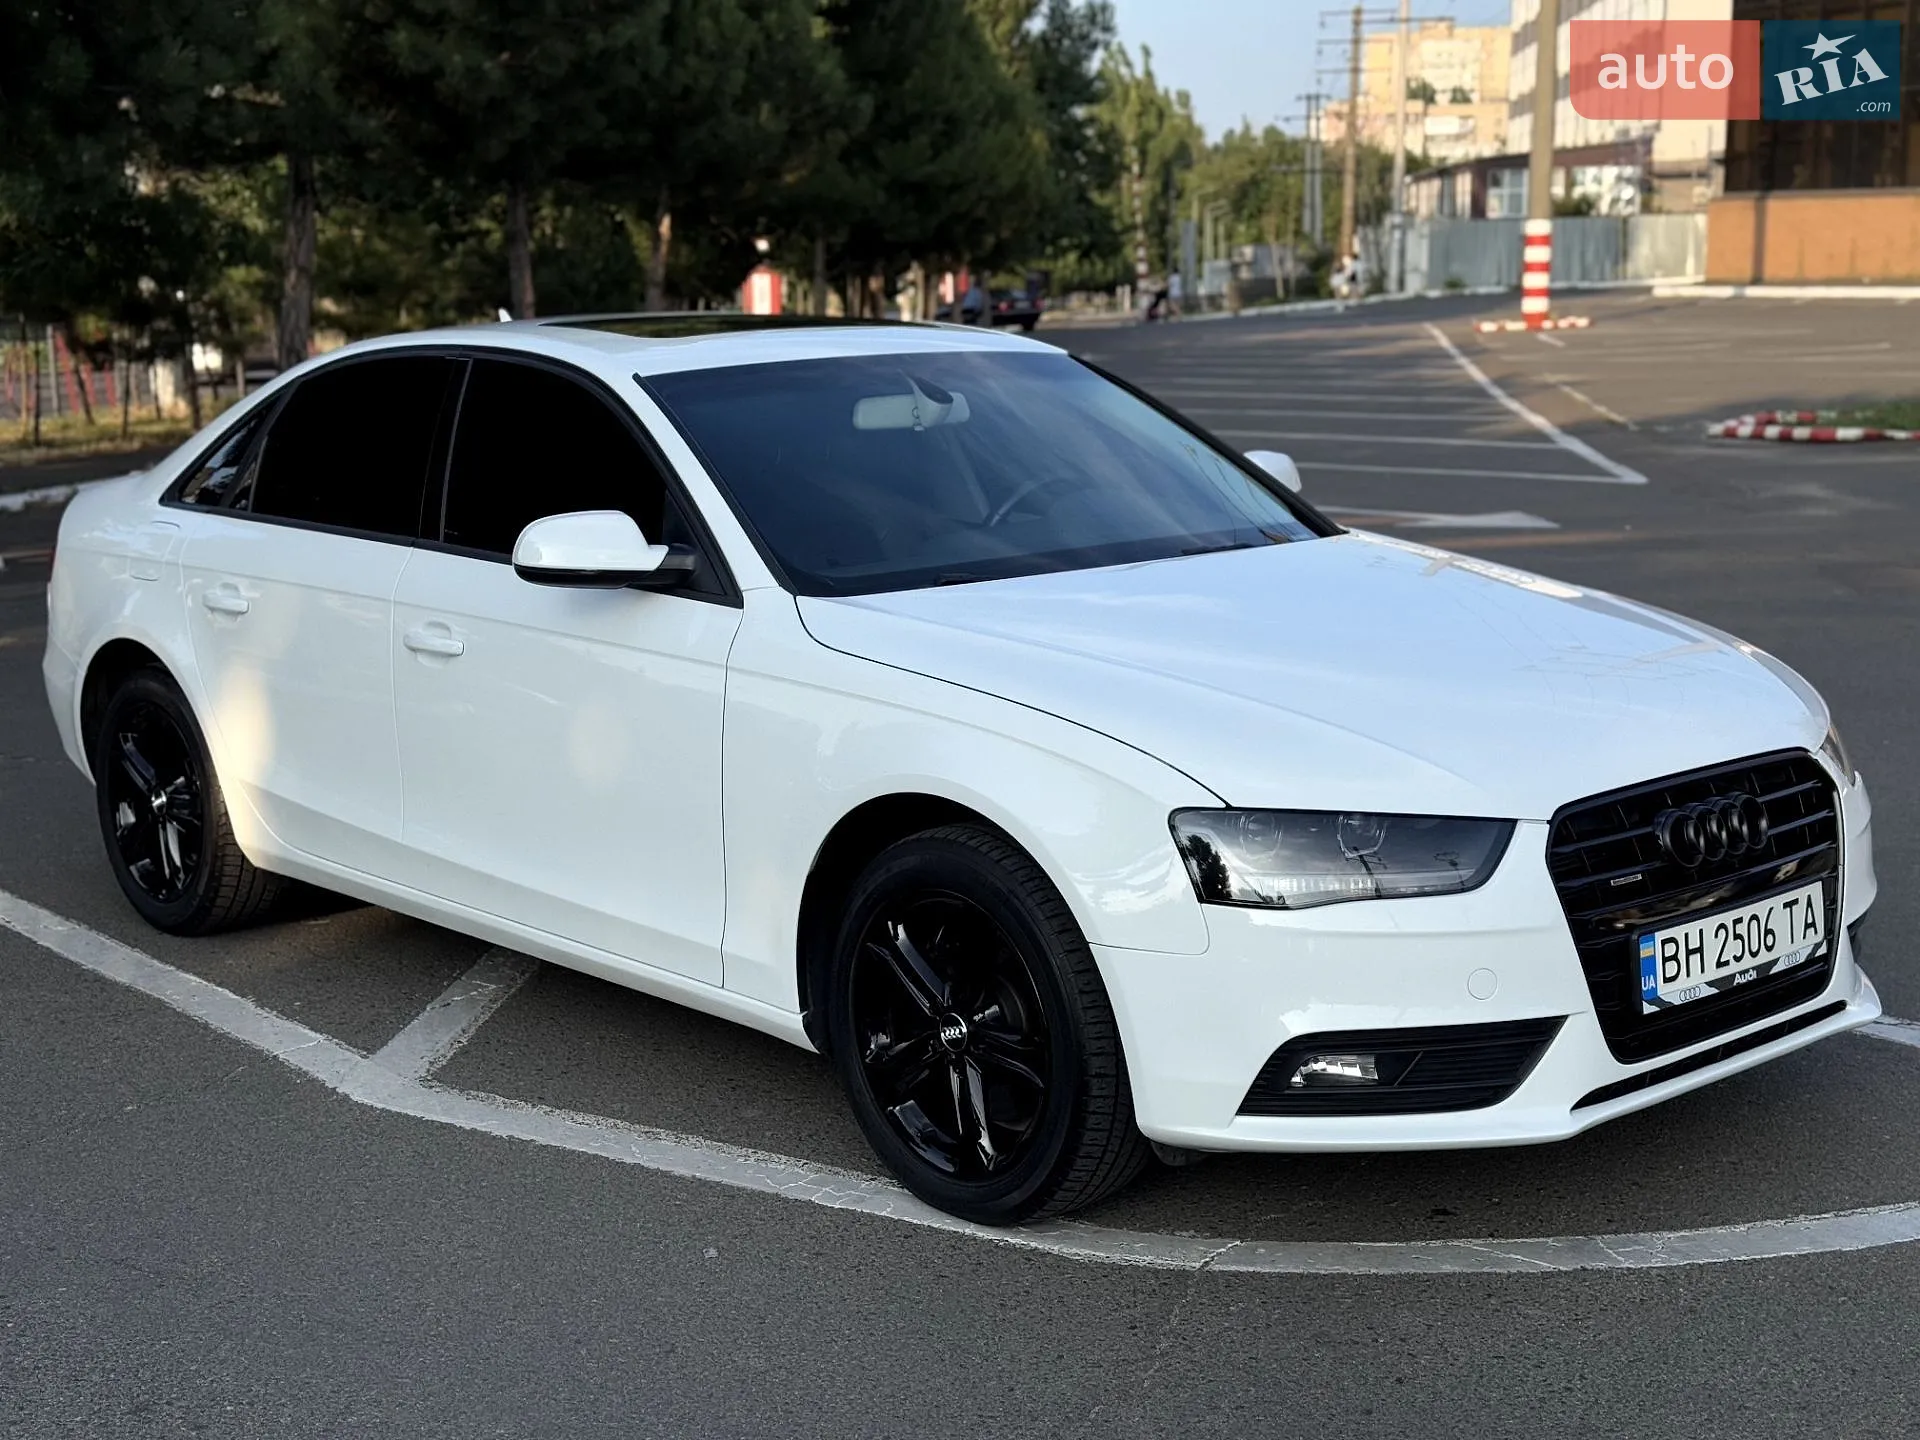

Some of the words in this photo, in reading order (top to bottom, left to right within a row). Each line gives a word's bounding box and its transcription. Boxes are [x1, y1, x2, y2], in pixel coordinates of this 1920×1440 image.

[1661, 928, 1705, 984] BH
[1714, 906, 1776, 970] 2506
[1782, 894, 1818, 945] TA
[1641, 975, 1656, 991] UA
[1733, 969, 1758, 986] Audi
